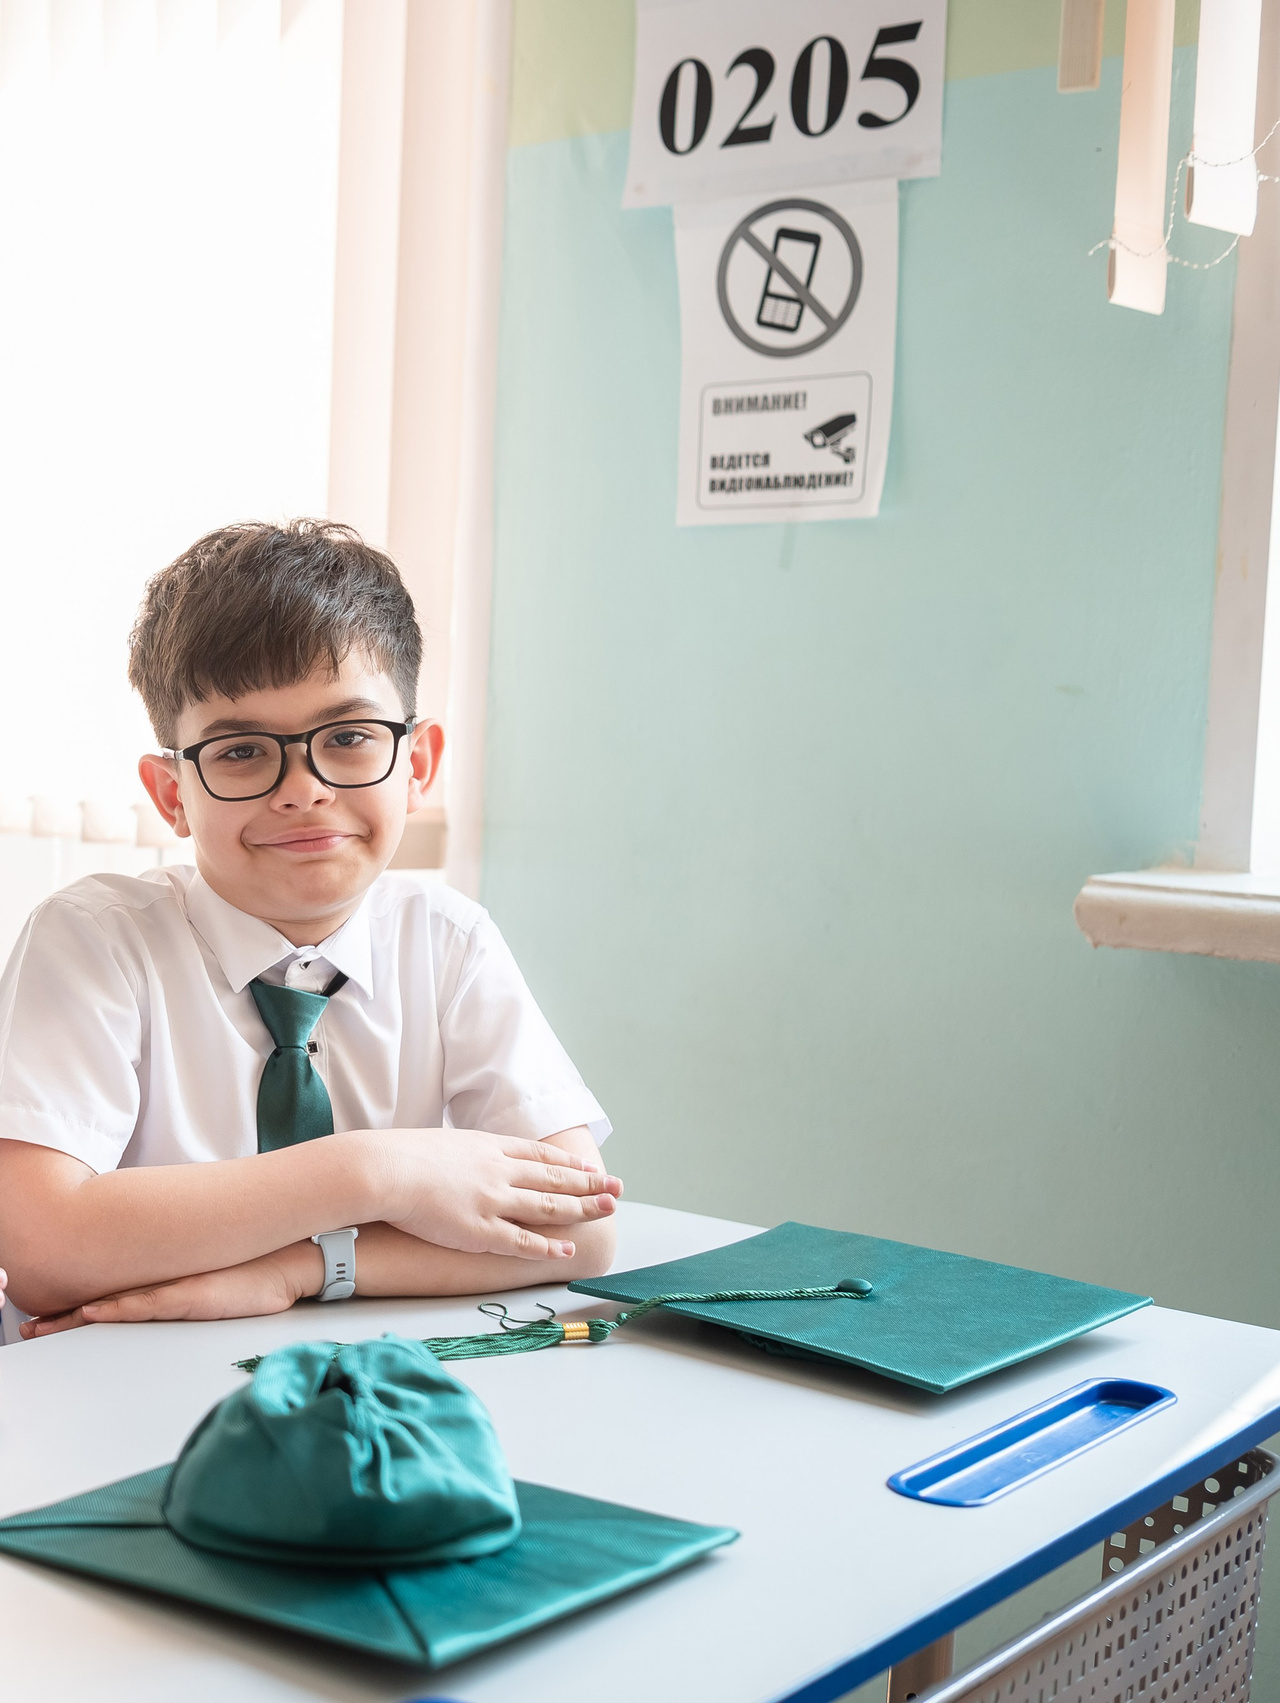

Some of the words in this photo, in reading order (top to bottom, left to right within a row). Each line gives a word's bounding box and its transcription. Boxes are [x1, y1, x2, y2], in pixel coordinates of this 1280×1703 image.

[658, 20, 924, 155] 0205
[711, 391, 808, 417] ВНИМАНИЕ!
[709, 452, 772, 472] ВЕДЕТСЯ
